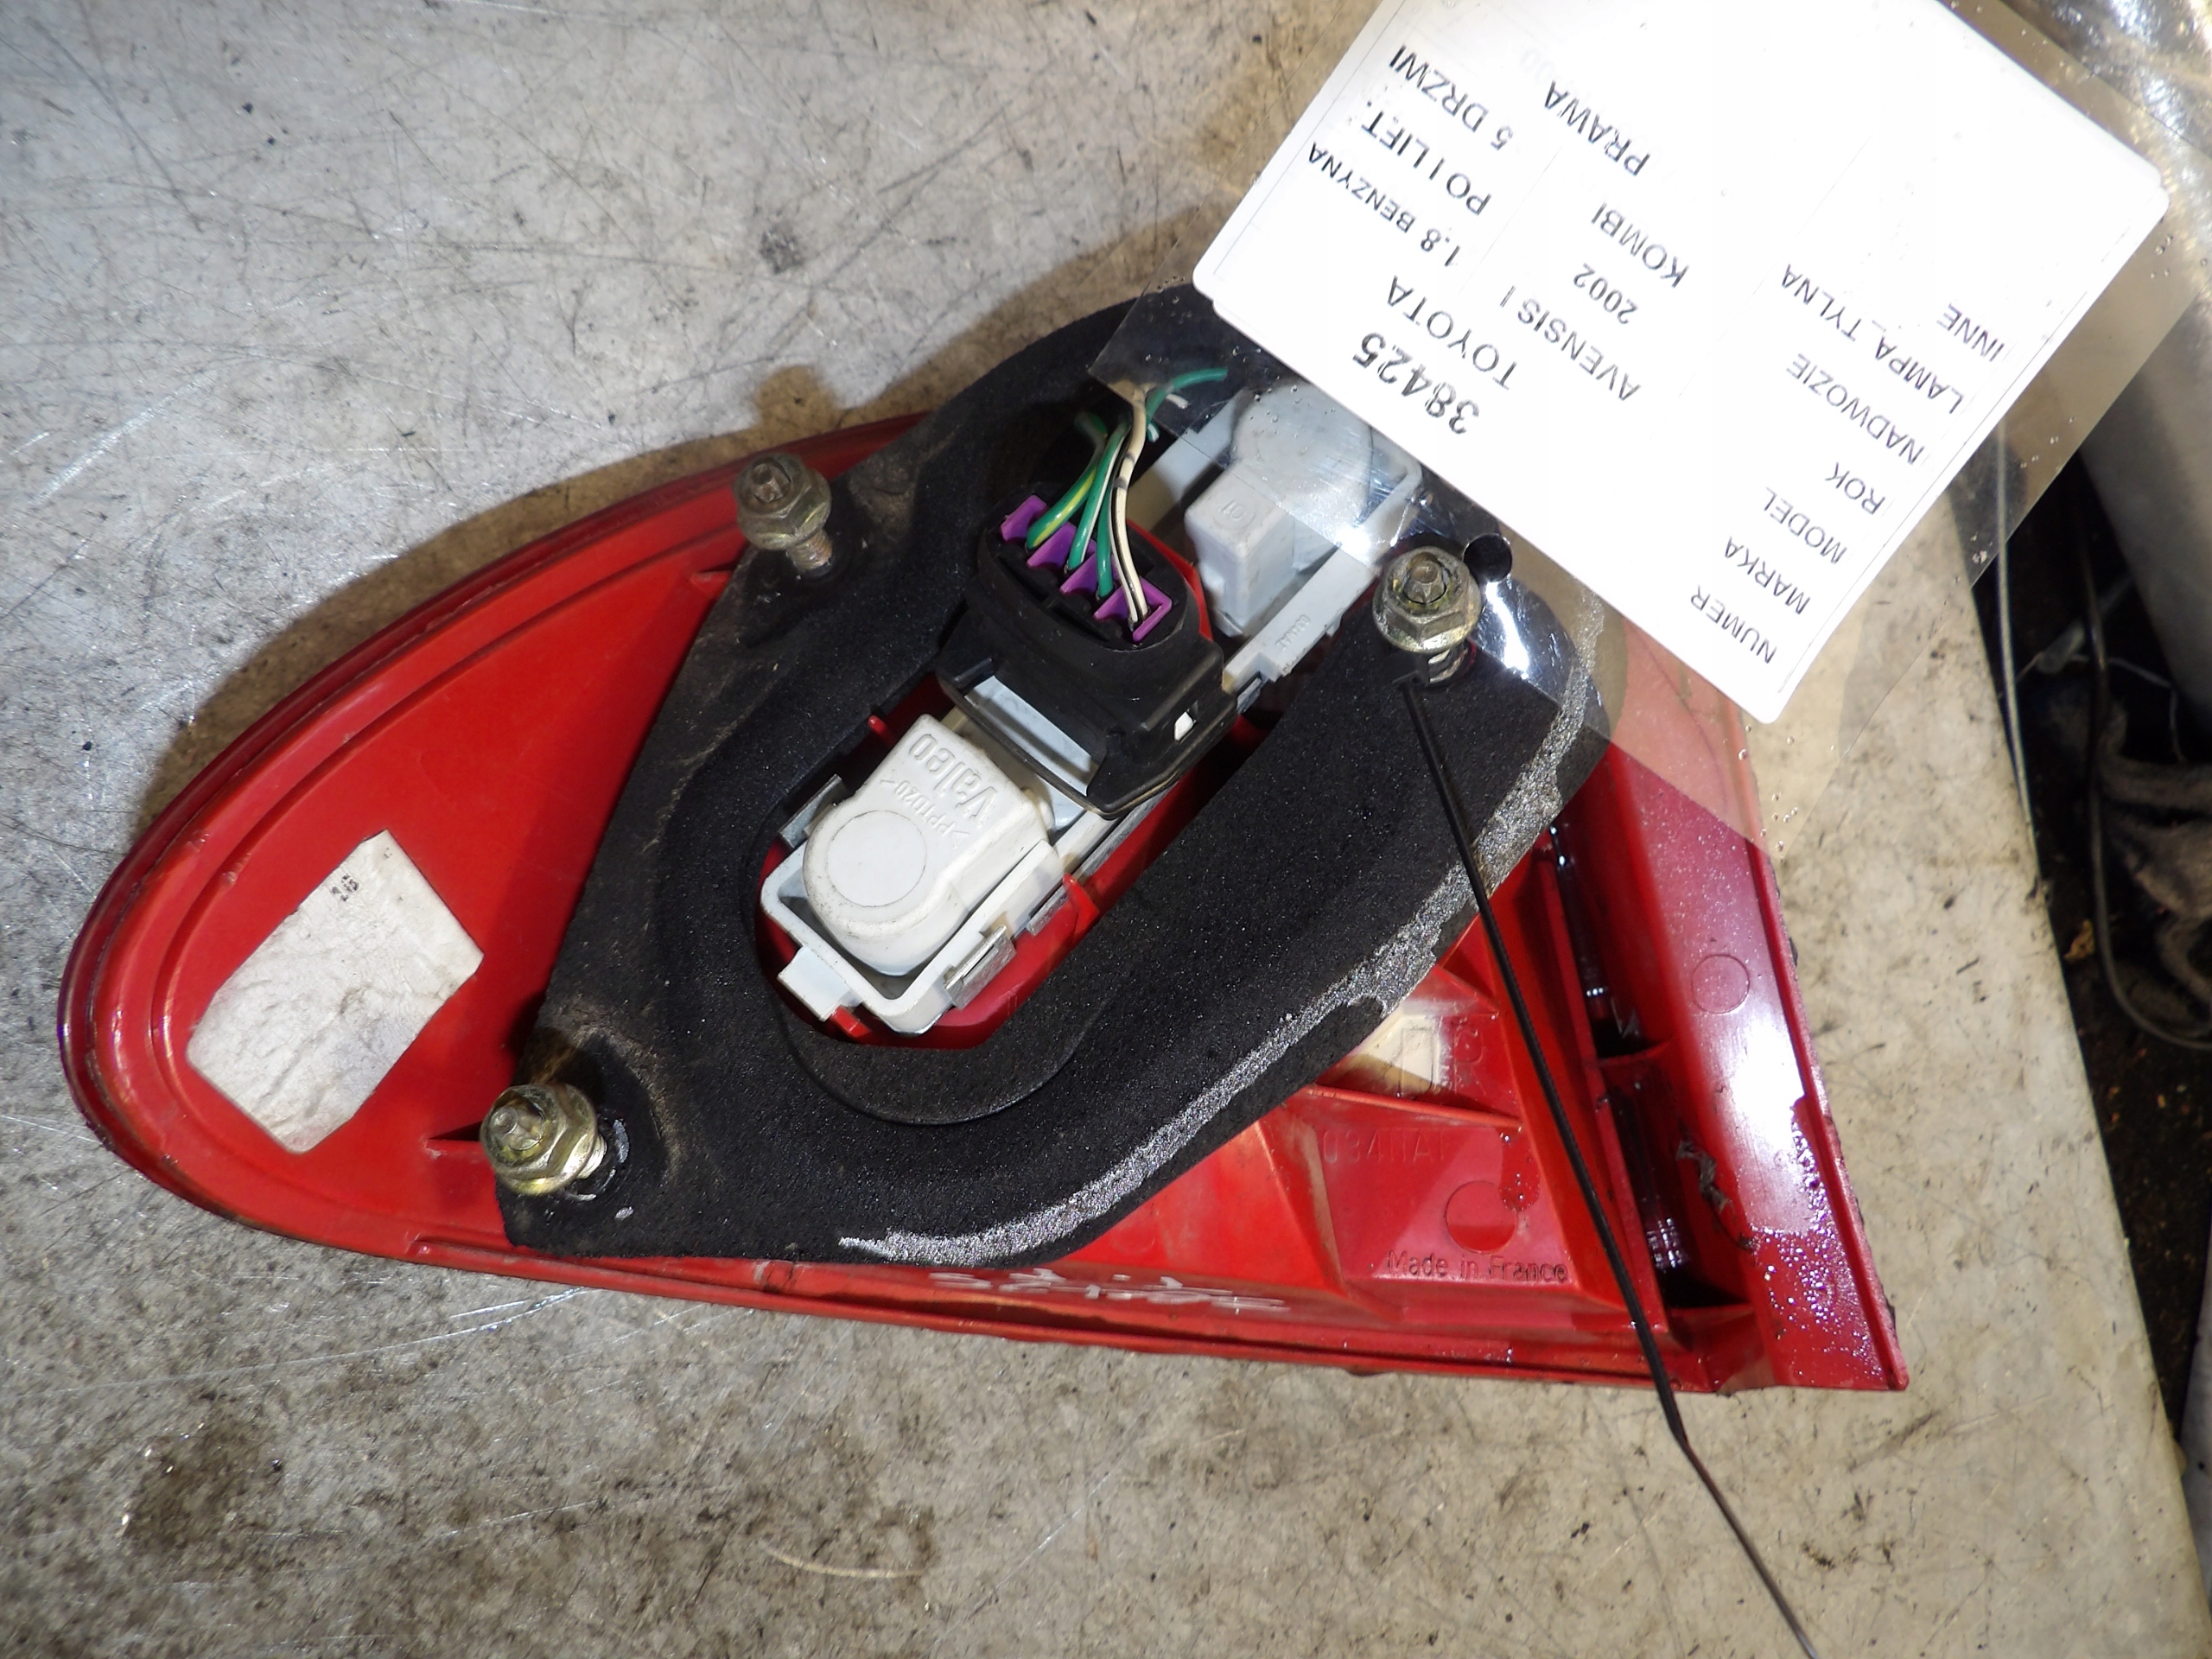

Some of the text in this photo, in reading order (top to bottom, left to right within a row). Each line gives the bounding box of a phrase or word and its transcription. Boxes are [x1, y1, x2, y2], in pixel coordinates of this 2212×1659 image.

[1388, 43, 1488, 132] DRZWI
[1490, 127, 1512, 150] 5
[1543, 79, 1650, 176] PRAWA
[1307, 141, 1460, 267] 1.8 BENZYNA
[1427, 157, 1445, 181] I
[1446, 172, 1491, 215] PO
[1591, 202, 1688, 288] KOMBI
[1387, 275, 1516, 389] TOYOTA
[1573, 263, 1637, 324] 2002
[1936, 302, 2005, 362] INNE
[1499, 283, 1640, 401] AVENSIS I
[1351, 332, 1479, 435] 38425
[1787, 353, 1924, 464] NADWOZIE
[1763, 487, 1847, 563] MODEL
[1824, 462, 1885, 515] ROK
[1724, 537, 1810, 614] MARKA
[1689, 586, 1776, 664] NUMER
[908, 734, 996, 827] Valeo
[1388, 1250, 1569, 1283] Made in France
